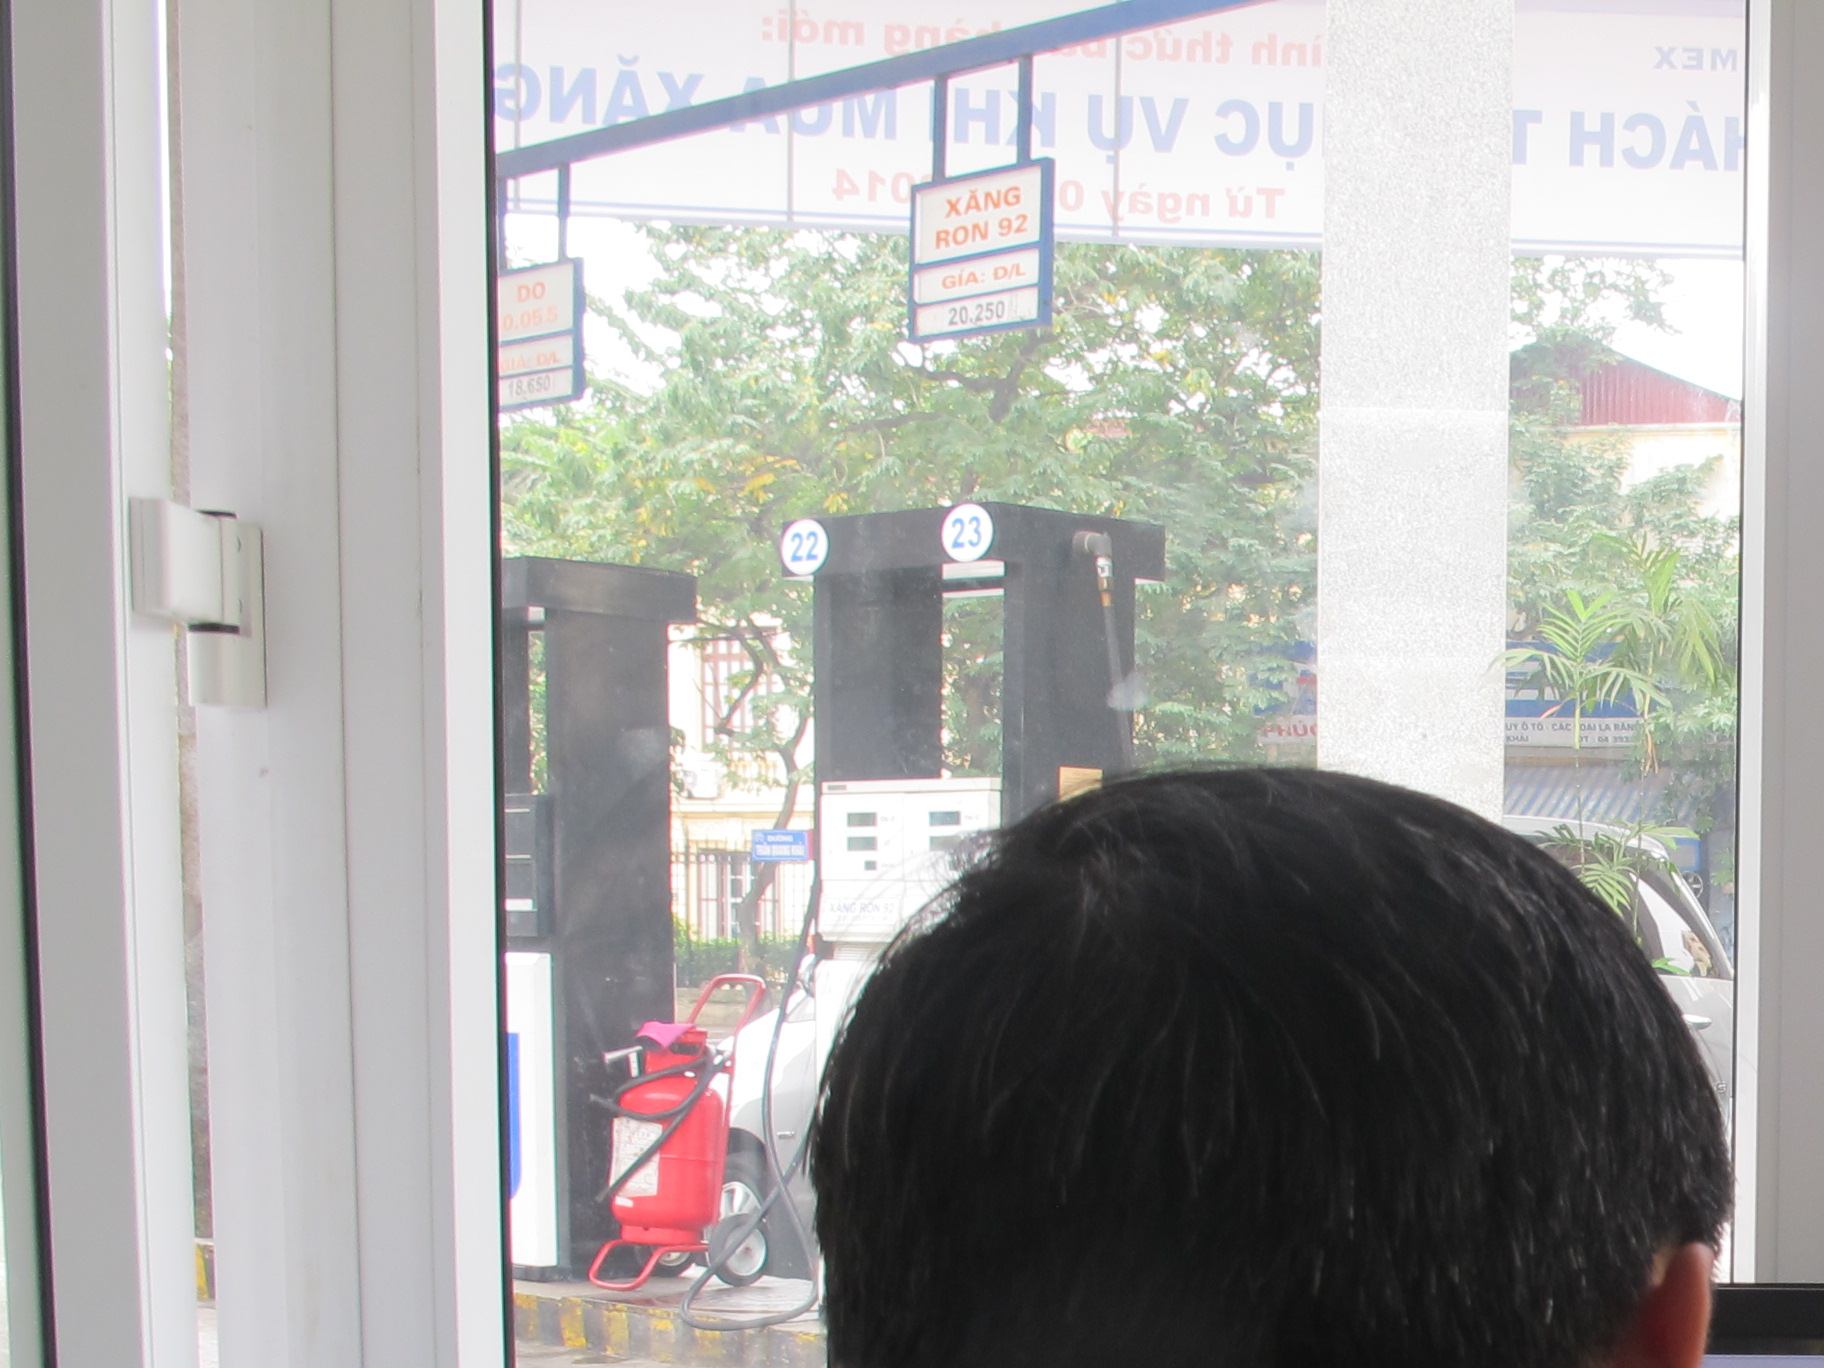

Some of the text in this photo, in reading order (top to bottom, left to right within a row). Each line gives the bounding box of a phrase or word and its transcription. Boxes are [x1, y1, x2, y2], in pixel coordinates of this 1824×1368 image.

[945, 186, 1022, 218] XĂNG
[935, 214, 1028, 249] RON 92
[993, 262, 1026, 280] Đ/L
[517, 281, 546, 303] DO
[948, 300, 1006, 327] 20.250
[790, 531, 819, 562] 22
[951, 516, 982, 549] 23
